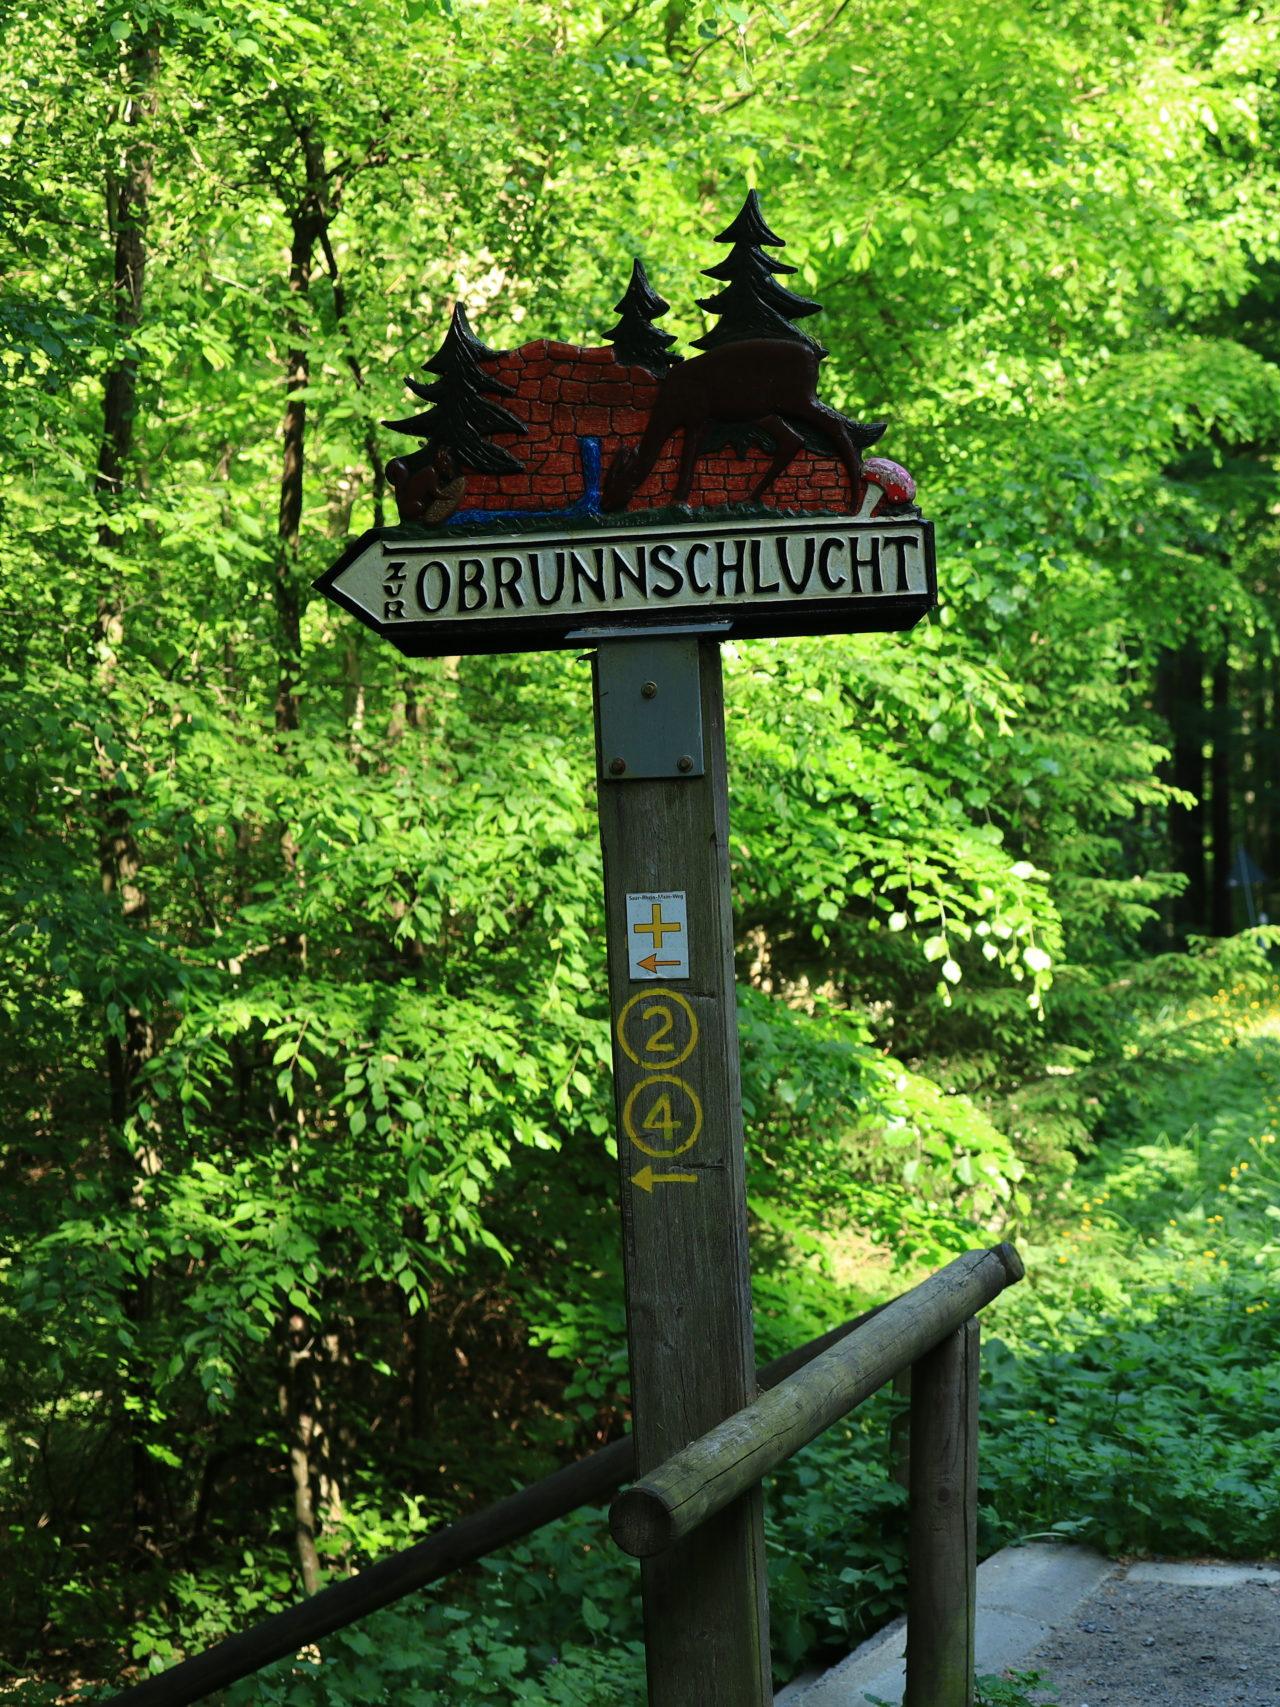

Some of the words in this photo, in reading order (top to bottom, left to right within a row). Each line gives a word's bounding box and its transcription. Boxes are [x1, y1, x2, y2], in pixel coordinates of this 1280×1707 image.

[383, 561, 407, 618] ZUR
[416, 535, 919, 613] OBRUNNSCHLUCHT
[642, 1005, 675, 1052] 2
[642, 1093, 681, 1139] 4
